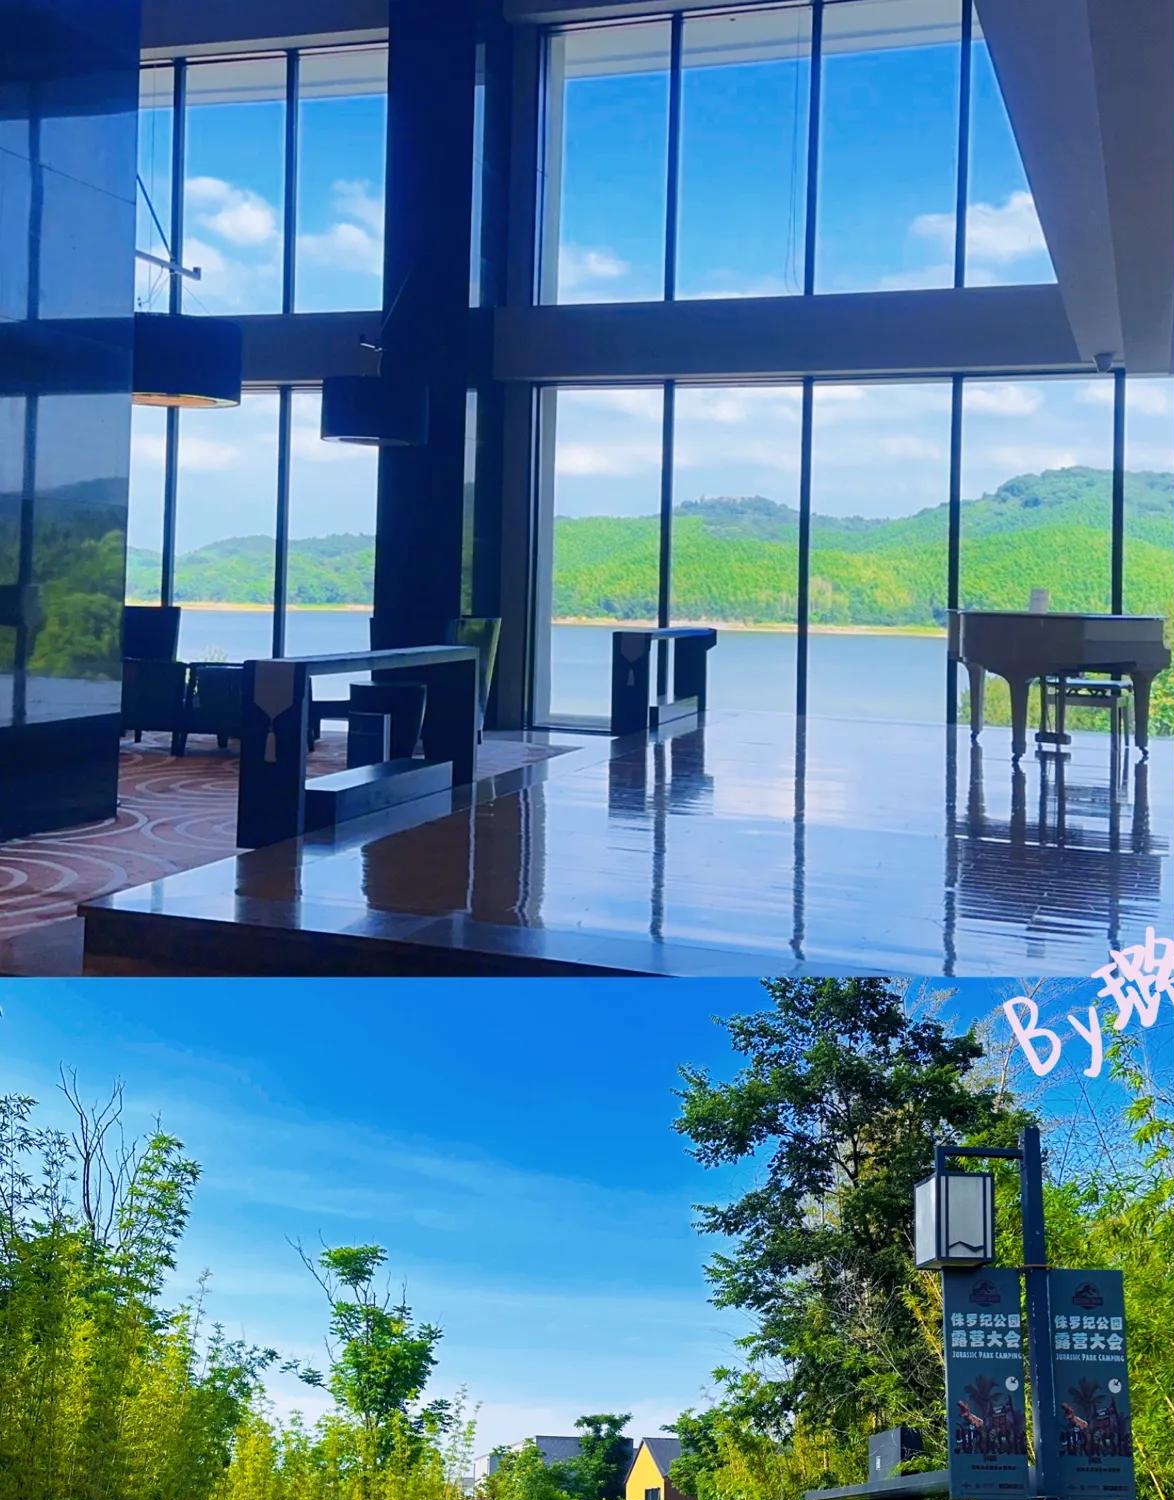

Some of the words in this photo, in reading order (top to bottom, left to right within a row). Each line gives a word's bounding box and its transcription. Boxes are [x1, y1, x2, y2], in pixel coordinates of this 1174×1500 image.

[951, 1312, 1021, 1328] 侏罗纪公园
[1055, 1315, 1123, 1330] 侏罗纪公园
[951, 1330, 1021, 1348] 露营大会
[1055, 1332, 1124, 1351] 露营大会
